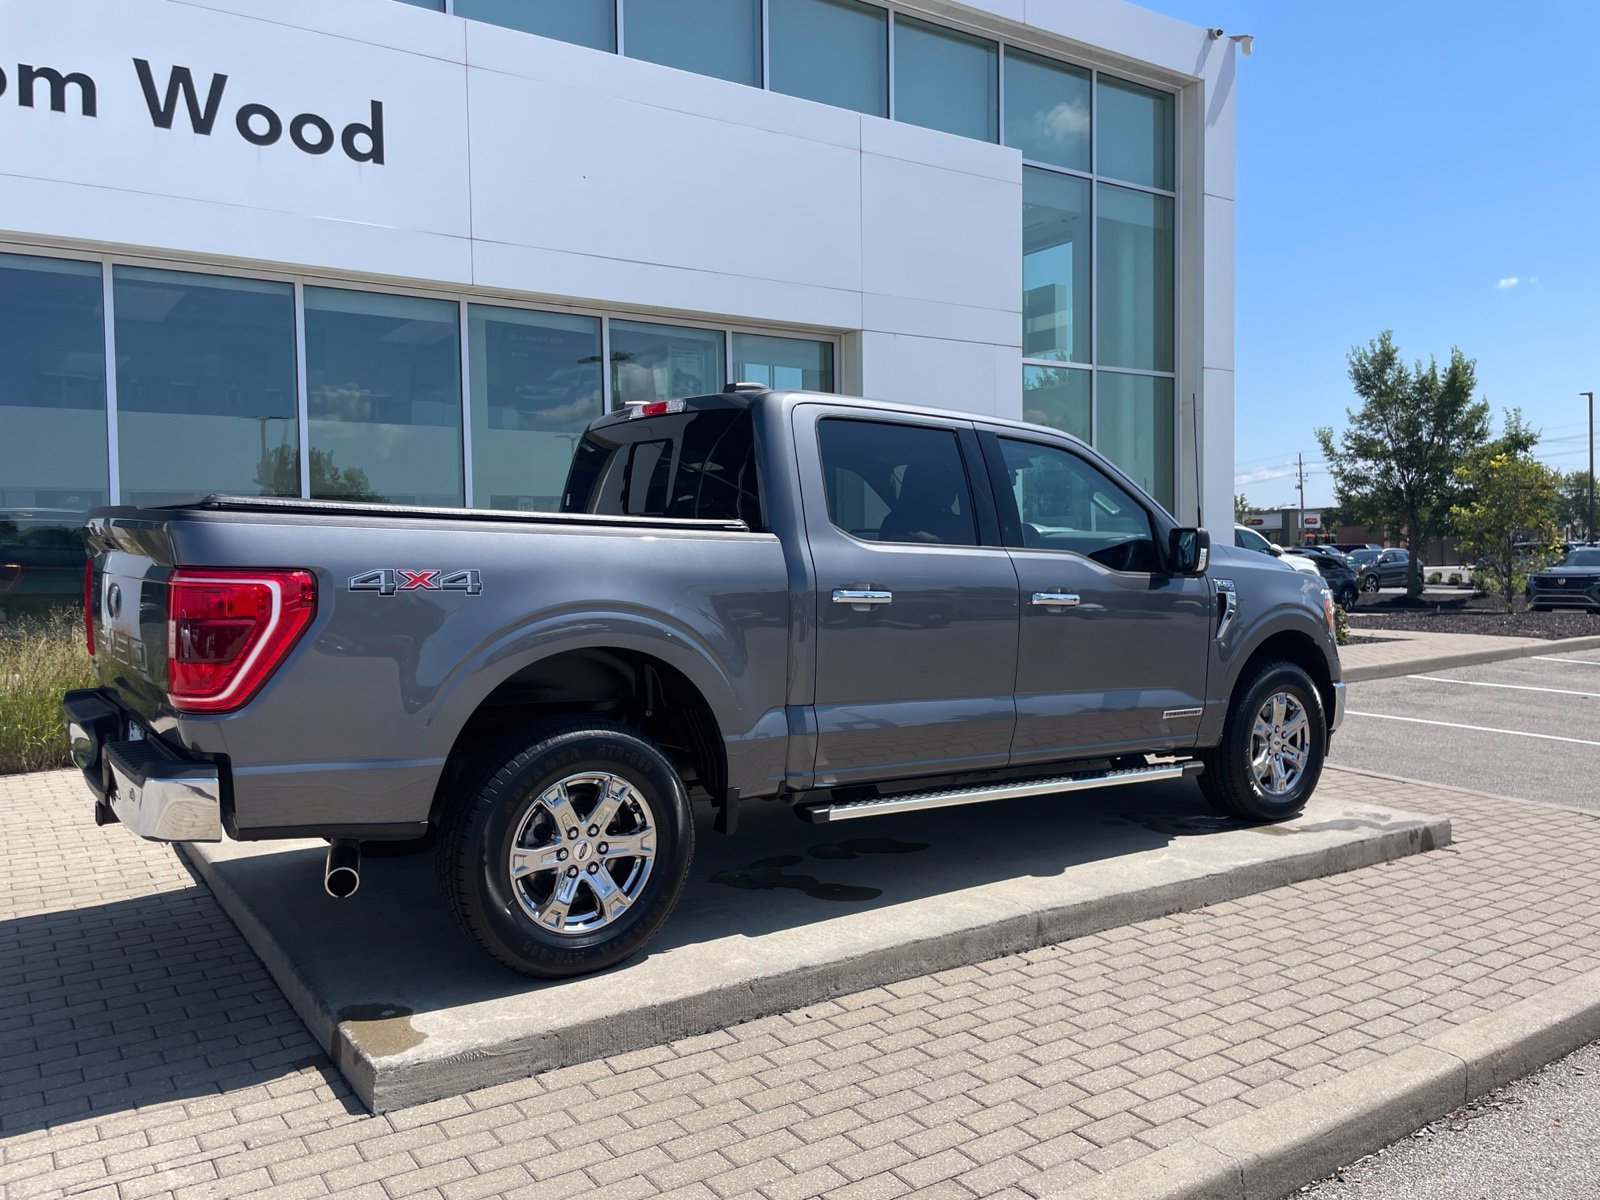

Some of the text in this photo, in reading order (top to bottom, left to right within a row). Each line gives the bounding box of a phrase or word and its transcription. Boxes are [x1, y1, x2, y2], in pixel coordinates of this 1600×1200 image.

[0, 57, 386, 165] m Wood
[347, 568, 484, 597] 4X4
